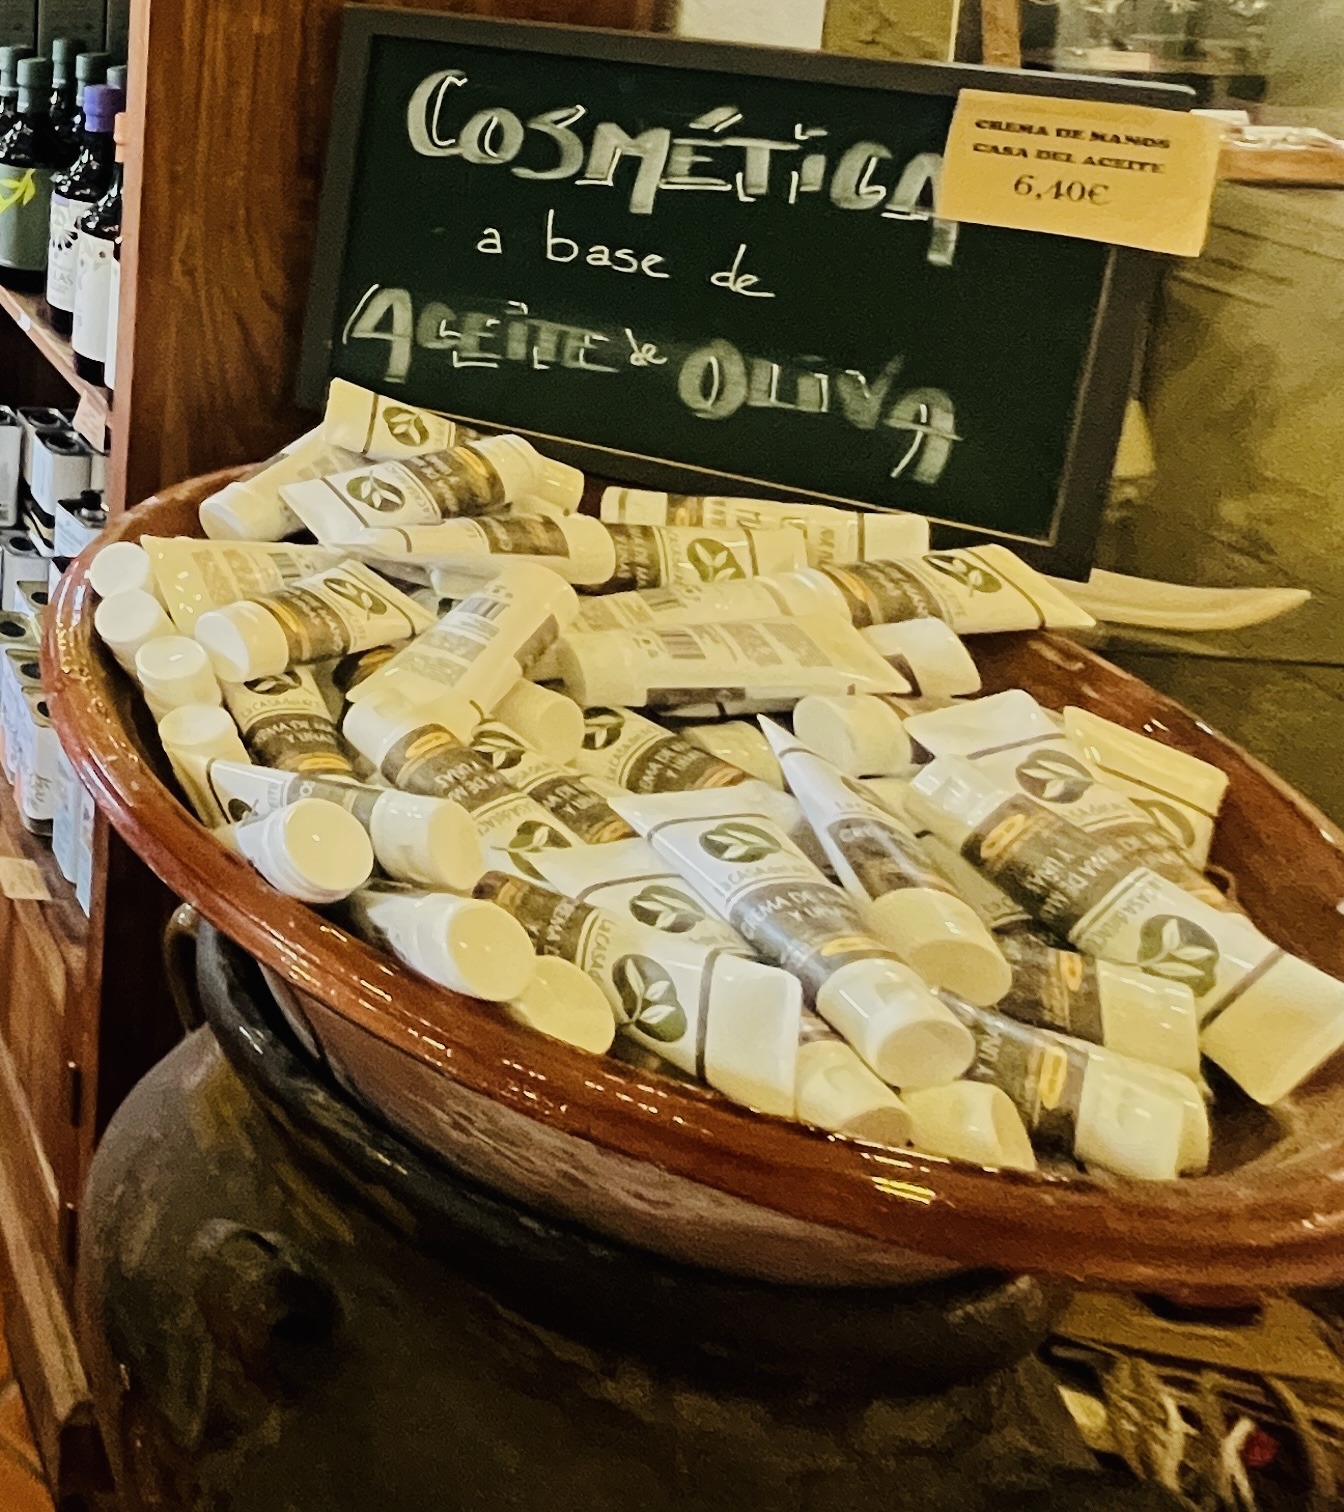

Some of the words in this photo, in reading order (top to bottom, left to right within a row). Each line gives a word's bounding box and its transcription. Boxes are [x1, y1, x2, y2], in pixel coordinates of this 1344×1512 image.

[974, 118, 1049, 137] CREMA
[1056, 126, 1085, 140] DE
[1090, 130, 1171, 150] MANOS
[973, 142, 1029, 159] CASA
[1035, 149, 1076, 165] DEL
[1081, 155, 1165, 174] ACEITE
[476, 227, 503, 255] a
[546, 208, 671, 279] base
[710, 242, 777, 298] de
